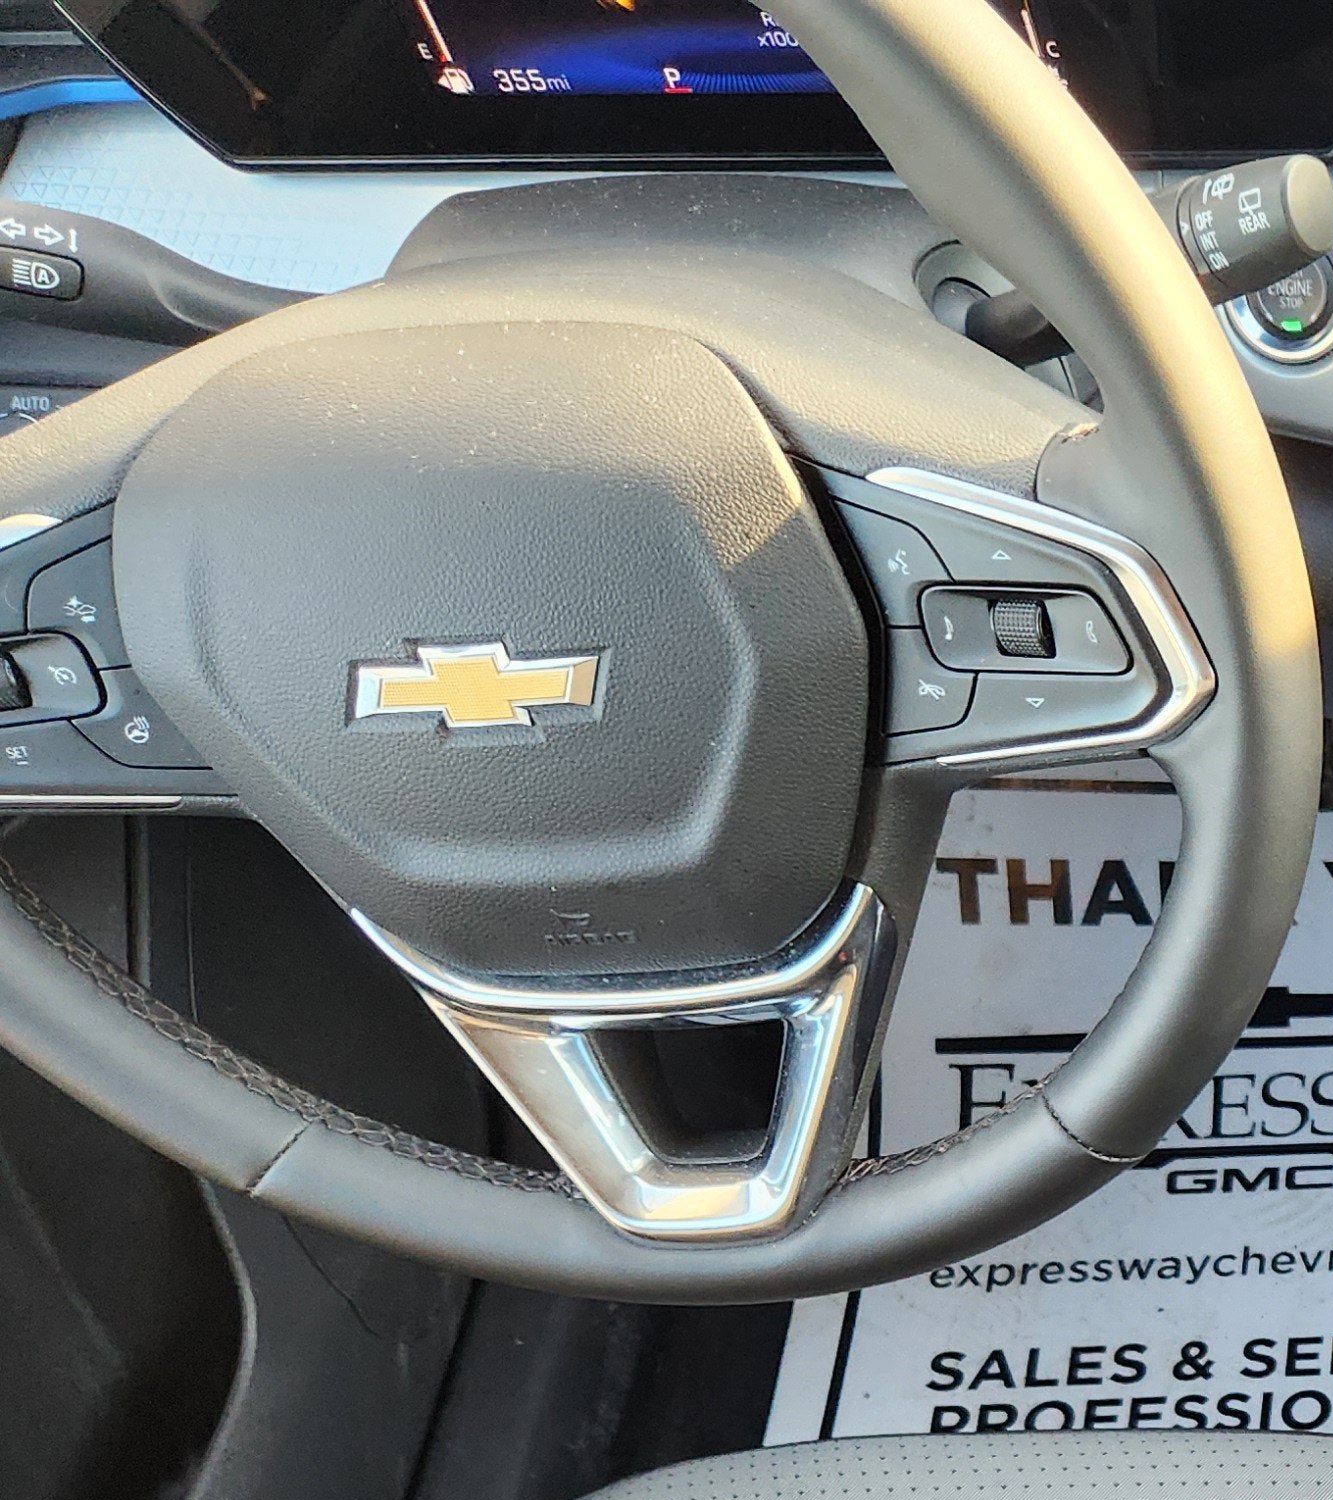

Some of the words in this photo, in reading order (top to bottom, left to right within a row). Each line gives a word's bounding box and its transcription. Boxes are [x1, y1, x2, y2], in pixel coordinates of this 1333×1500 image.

[1045, 41, 1060, 59] C
[663, 67, 682, 88] P
[1195, 211, 1213, 230] OFF
[1238, 212, 1271, 235] REAR
[1200, 231, 1219, 251] INT
[1208, 252, 1230, 271] ON
[11, 395, 51, 411] AUTO
[935, 857, 1298, 926] THA
[926, 1343, 1149, 1391] SALES
[1171, 1341, 1215, 1381] &
